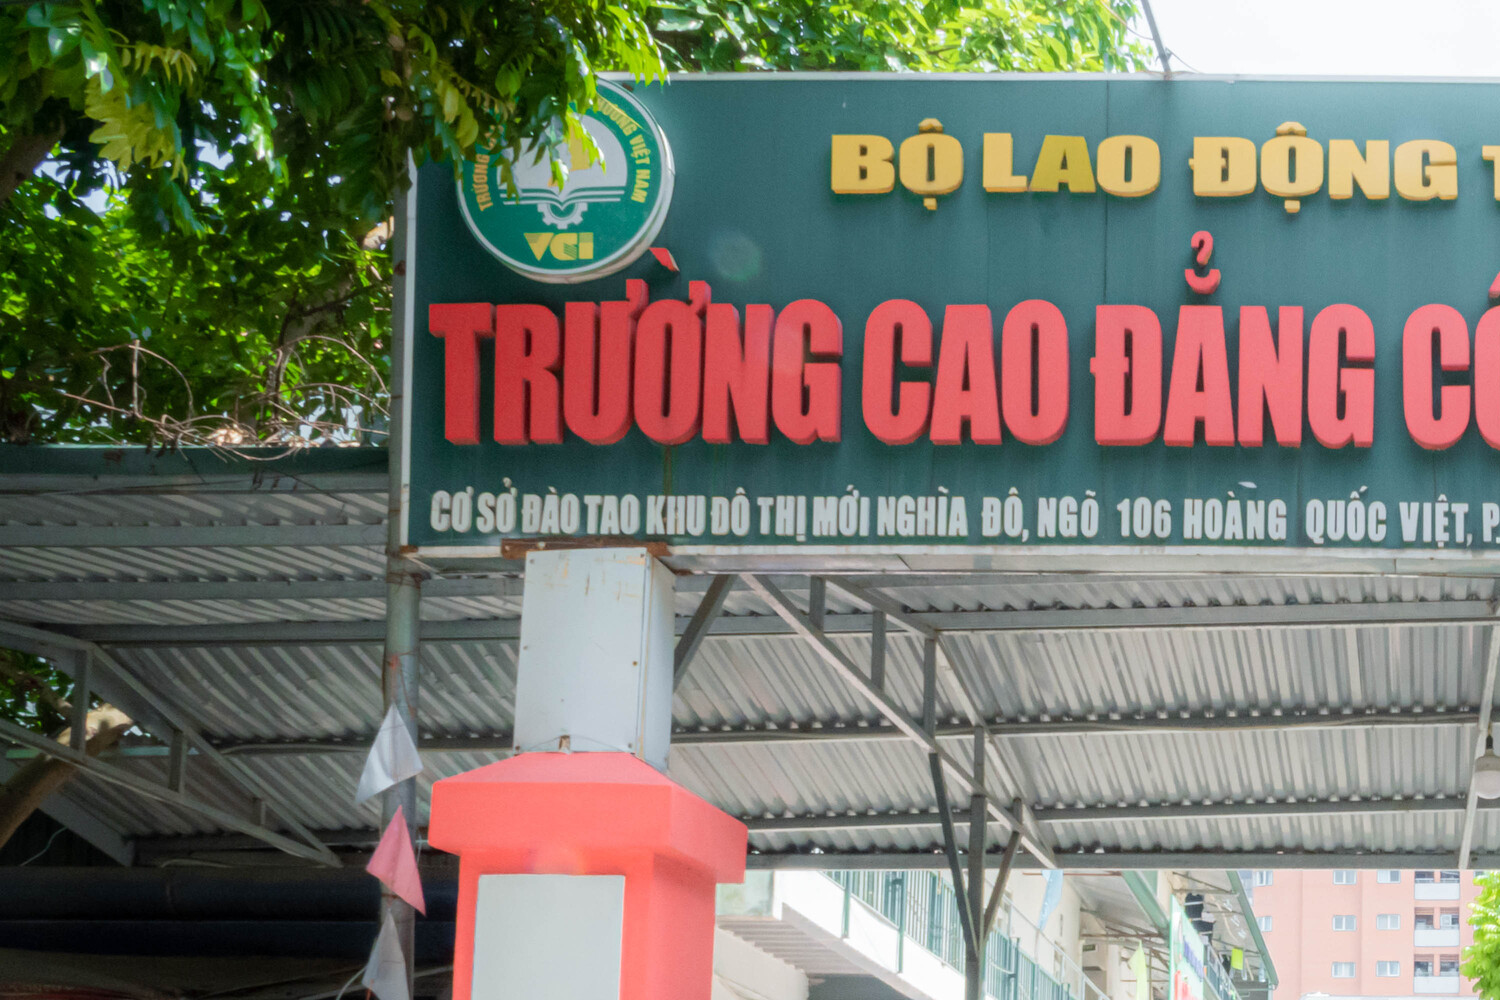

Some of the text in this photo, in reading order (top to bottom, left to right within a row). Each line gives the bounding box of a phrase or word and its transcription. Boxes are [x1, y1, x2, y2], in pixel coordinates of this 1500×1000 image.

[629, 134, 651, 165] VIỆT
[830, 118, 964, 210] BỘ
[983, 132, 1160, 197] LAO
[1189, 122, 1458, 213] ĐỘNG
[631, 169, 651, 203] NAM
[523, 232, 594, 261] VCI
[428, 248, 843, 447] TRƯỜNG
[862, 298, 1070, 446] CAO
[1090, 231, 1376, 449] ĐẲNG
[430, 486, 474, 533] CƠ
[476, 477, 517, 533] SỞ
[521, 486, 580, 534] ĐÀO
[646, 494, 705, 536] KHU
[711, 487, 750, 537] ĐÔ
[757, 496, 806, 542] THỊ
[813, 484, 869, 537] MỚI
[877, 486, 969, 537] NGHĨA
[981, 487, 1030, 543] ĐÔ,
[1037, 489, 1100, 538] NGÕ
[1116, 498, 1172, 539] 106
[1183, 490, 1287, 541] HOÀNG
[1305, 486, 1388, 544] QUỐC
[1399, 494, 1473, 547] VIỆT,
